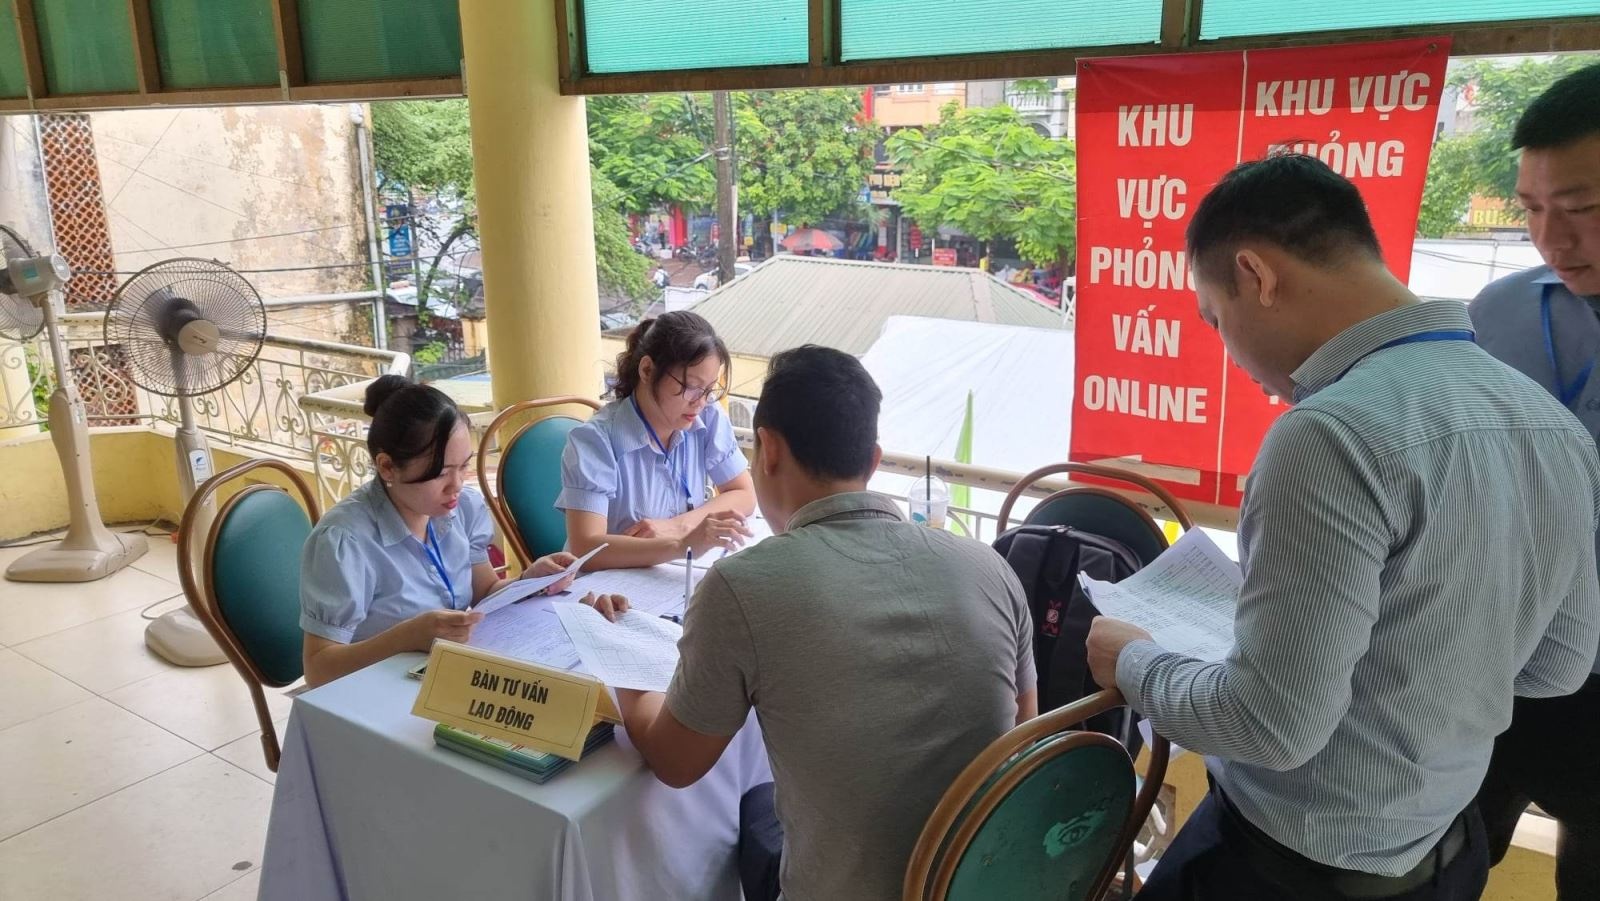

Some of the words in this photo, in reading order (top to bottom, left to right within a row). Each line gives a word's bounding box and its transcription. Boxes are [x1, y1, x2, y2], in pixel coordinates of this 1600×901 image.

[1255, 79, 1335, 117] KHU
[1349, 70, 1430, 121] VỰC
[1118, 103, 1194, 147] KHU
[1117, 174, 1187, 229] VỰC
[1090, 236, 1197, 291] PHỎN
[1112, 304, 1181, 358] VẤN
[1083, 375, 1208, 424] ONLINE
[470, 669, 500, 692] BÀN
[502, 677, 521, 697] TƯ
[521, 680, 549, 705] VẤN
[468, 699, 495, 720] LAO
[495, 706, 535, 731] ĐỘNG
